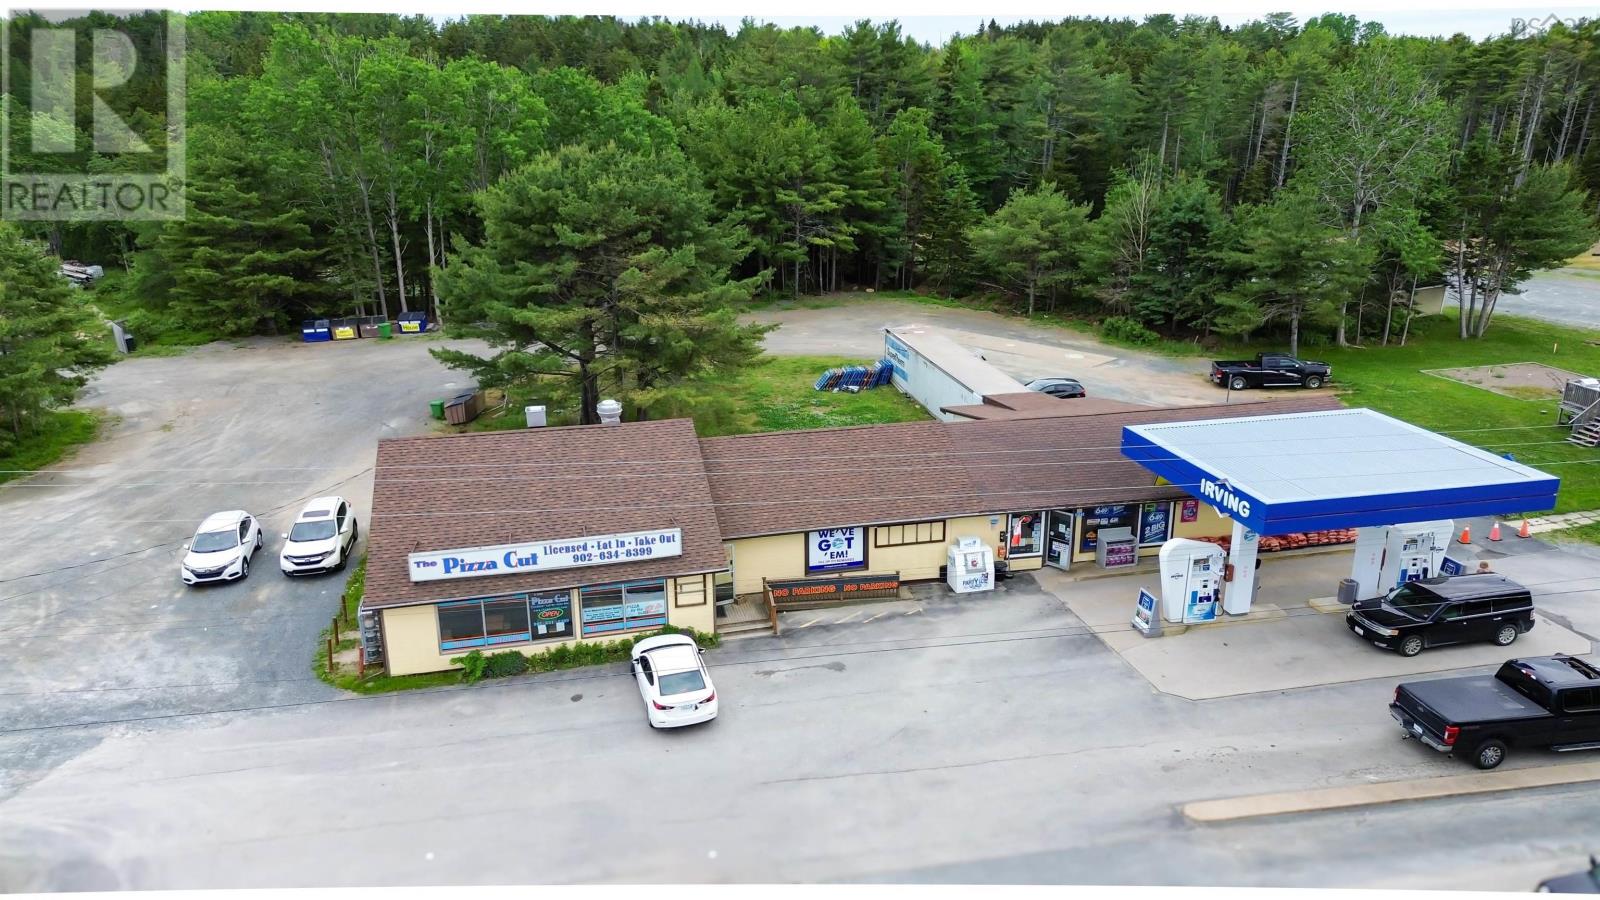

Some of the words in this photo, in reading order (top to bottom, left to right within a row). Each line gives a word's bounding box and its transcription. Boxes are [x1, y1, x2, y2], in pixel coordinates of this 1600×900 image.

[1200, 478, 1250, 518] IRVING
[1151, 521, 1166, 532] BIG
[543, 542, 588, 555] Licensed
[597, 540, 612, 550] Eat
[616, 539, 625, 548] In
[634, 536, 656, 546] Take
[659, 534, 675, 544] Out
[442, 557, 498, 574] Pizza
[503, 550, 538, 568] Cut
[573, 547, 653, 563] 902-634-8399
[773, 588, 789, 597] NO
[792, 584, 836, 596] PARKING
[843, 583, 858, 592] NO
[860, 581, 899, 591] PARKING
